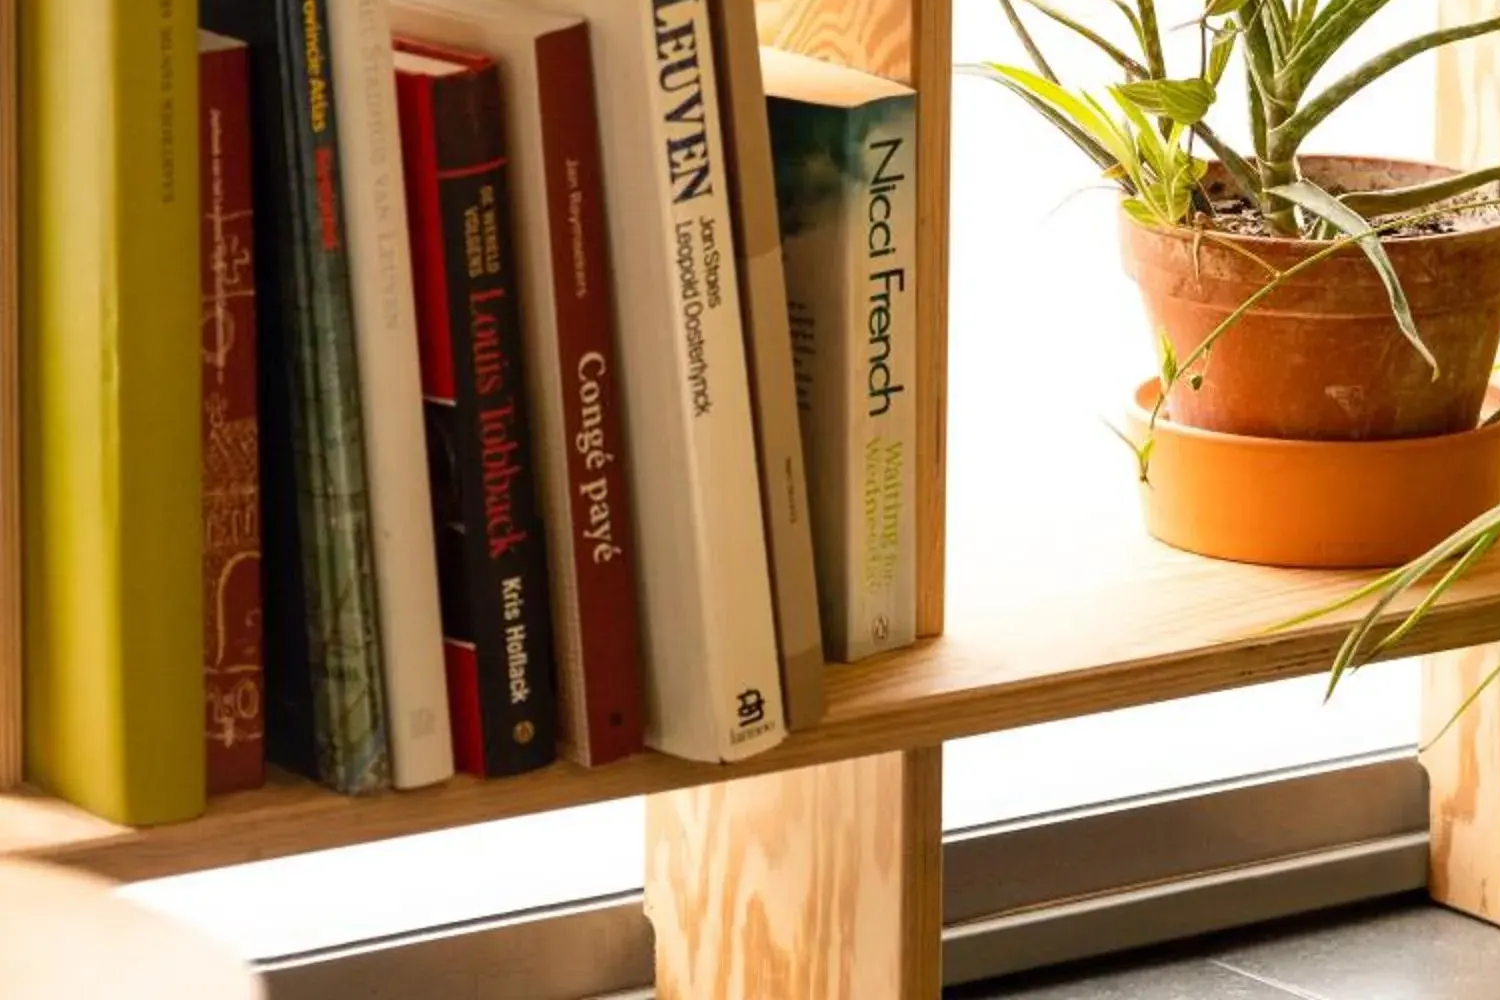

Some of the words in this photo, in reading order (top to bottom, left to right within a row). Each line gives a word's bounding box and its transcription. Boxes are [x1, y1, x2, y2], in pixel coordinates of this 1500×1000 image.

[311, 77, 328, 133] Atlas
[700, 215, 716, 251] Jan
[868, 137, 905, 258] Nicci
[675, 220, 701, 300] Leopold
[469, 287, 508, 395] Louis
[868, 268, 905, 417] French
[575, 352, 615, 471] Congé
[479, 402, 528, 560] Tobback
[579, 476, 622, 564] payé
[501, 575, 522, 621] Kris
[505, 626, 532, 704] Hoflack
